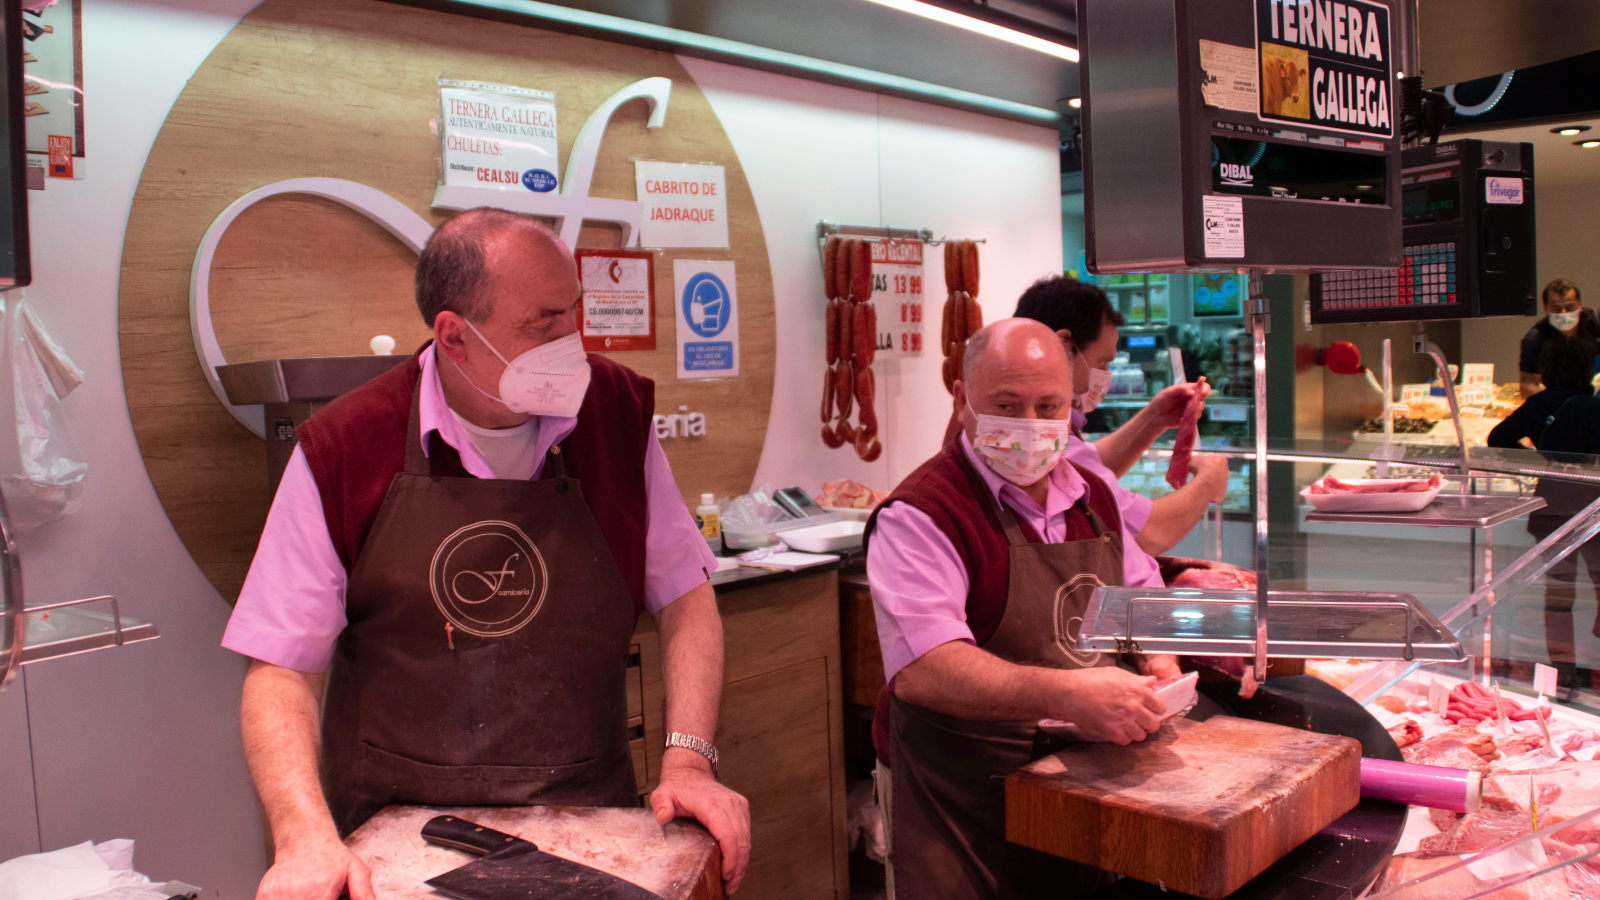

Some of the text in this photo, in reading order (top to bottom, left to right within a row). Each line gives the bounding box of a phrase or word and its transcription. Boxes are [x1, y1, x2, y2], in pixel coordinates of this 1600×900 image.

[1270, 0, 1383, 62] TERNERA
[1312, 67, 1390, 129] GALLEGA
[448, 98, 555, 128] TERNERA GALLEGA
[448, 116, 556, 139] AUTENTICAMENTE NATURAL
[50, 137, 71, 149] ENJOY
[447, 135, 502, 156] CHULETAS:
[1436, 144, 1457, 154] DIBAL
[50, 155, 71, 166] EUROPE
[477, 167, 519, 185] CEALSU
[1220, 162, 1254, 180] DIBAL
[645, 180, 717, 196] CABRITO DE
[650, 207, 715, 223] JADRAQUE
[871, 242, 887, 261] ERO
